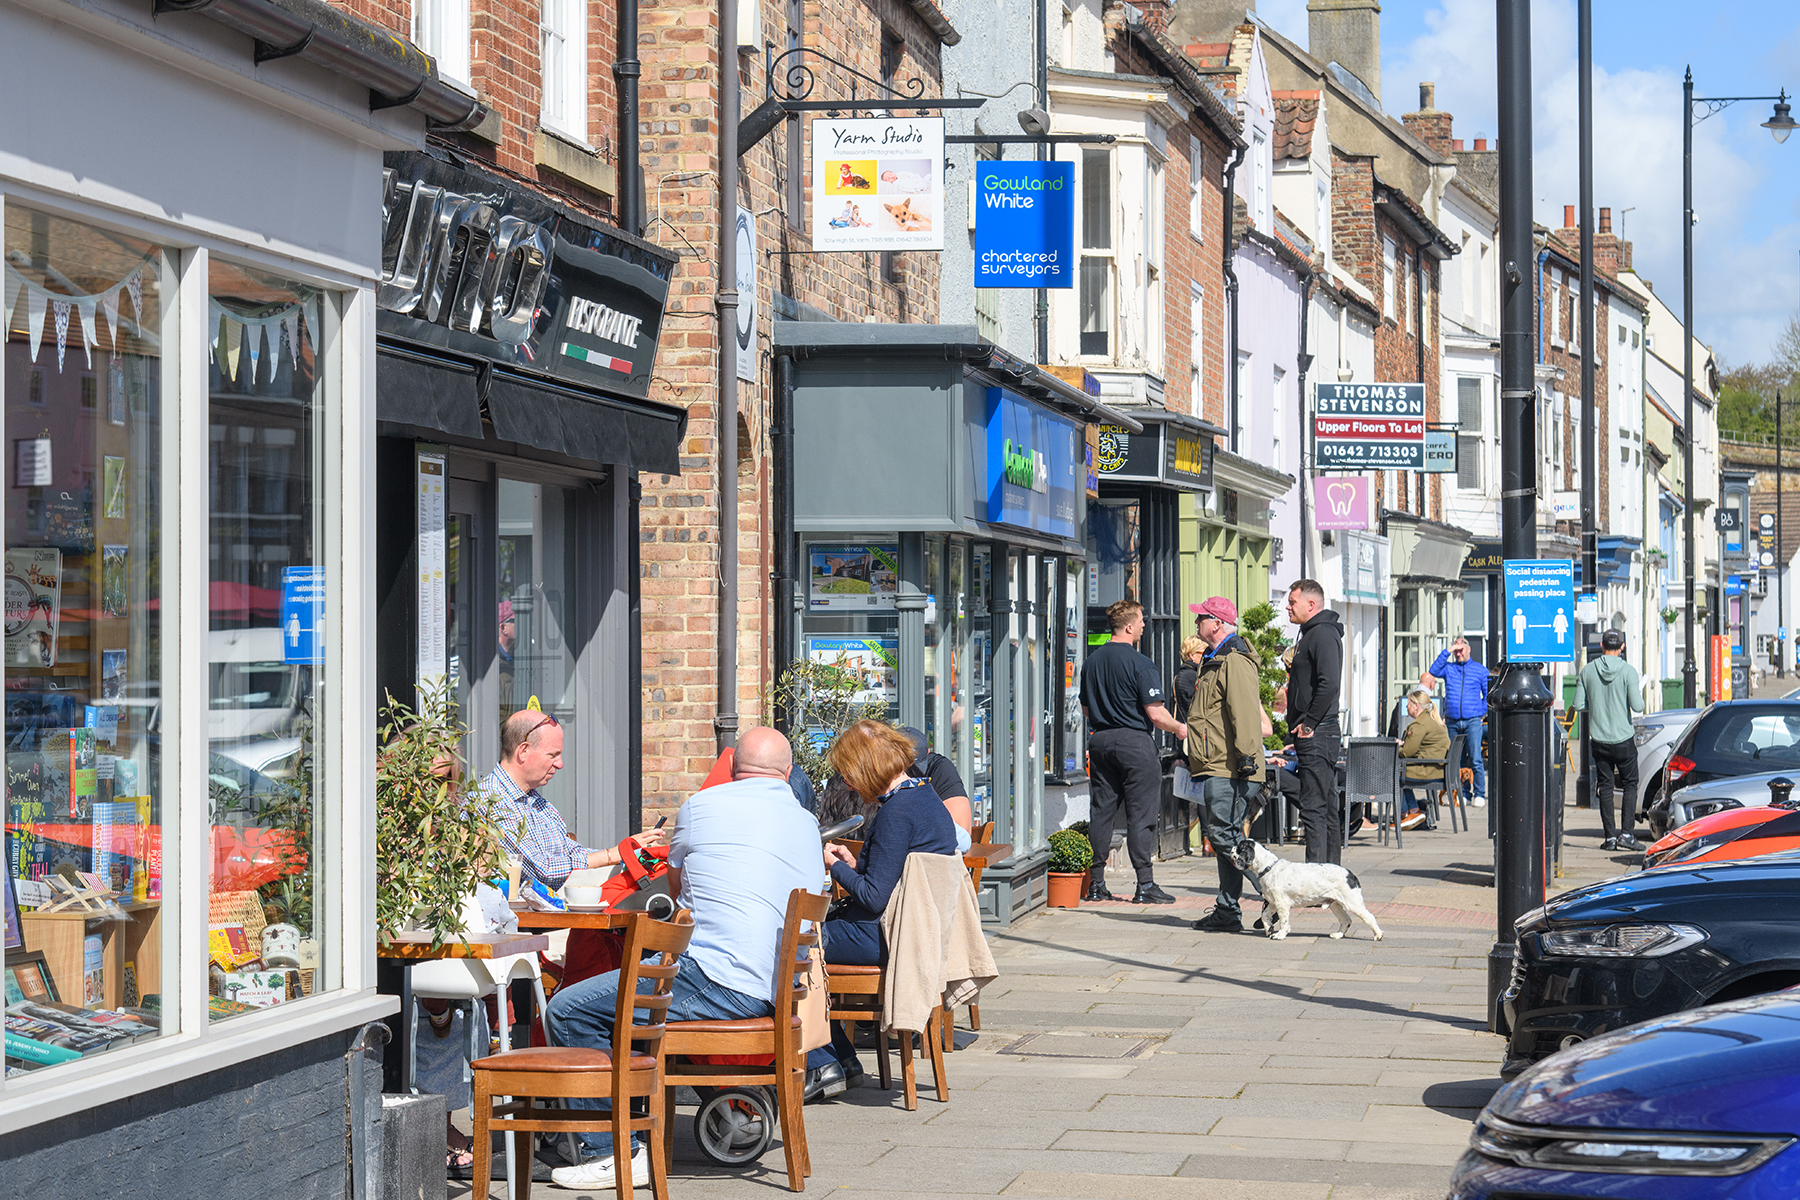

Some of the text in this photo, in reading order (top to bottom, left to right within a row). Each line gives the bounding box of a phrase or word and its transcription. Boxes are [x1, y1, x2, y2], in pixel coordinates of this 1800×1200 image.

[831, 124, 923, 149] Yarm Studio
[983, 174, 1063, 191] Gowland
[984, 192, 1034, 209] White
[981, 249, 1058, 263] chartered
[981, 264, 1060, 278] surveyors
[566, 295, 643, 349] RISTORANTE
[1334, 386, 1407, 399] THOMAS
[1319, 399, 1421, 413] STEVENSON
[1317, 421, 1422, 434] Upper Floors To Let
[1323, 445, 1418, 458] 01642 713303
[878, 553, 897, 571] AGREED
[1468, 557, 1486, 568] CASK
[1506, 567, 1571, 577] Social distancing
[1519, 578, 1560, 588] pedestrian
[1514, 589, 1544, 599] passing
[1545, 588, 1566, 599] place
[868, 641, 897, 667] SALE AGREED
[12, 1041, 32, 1051] JEREMY
